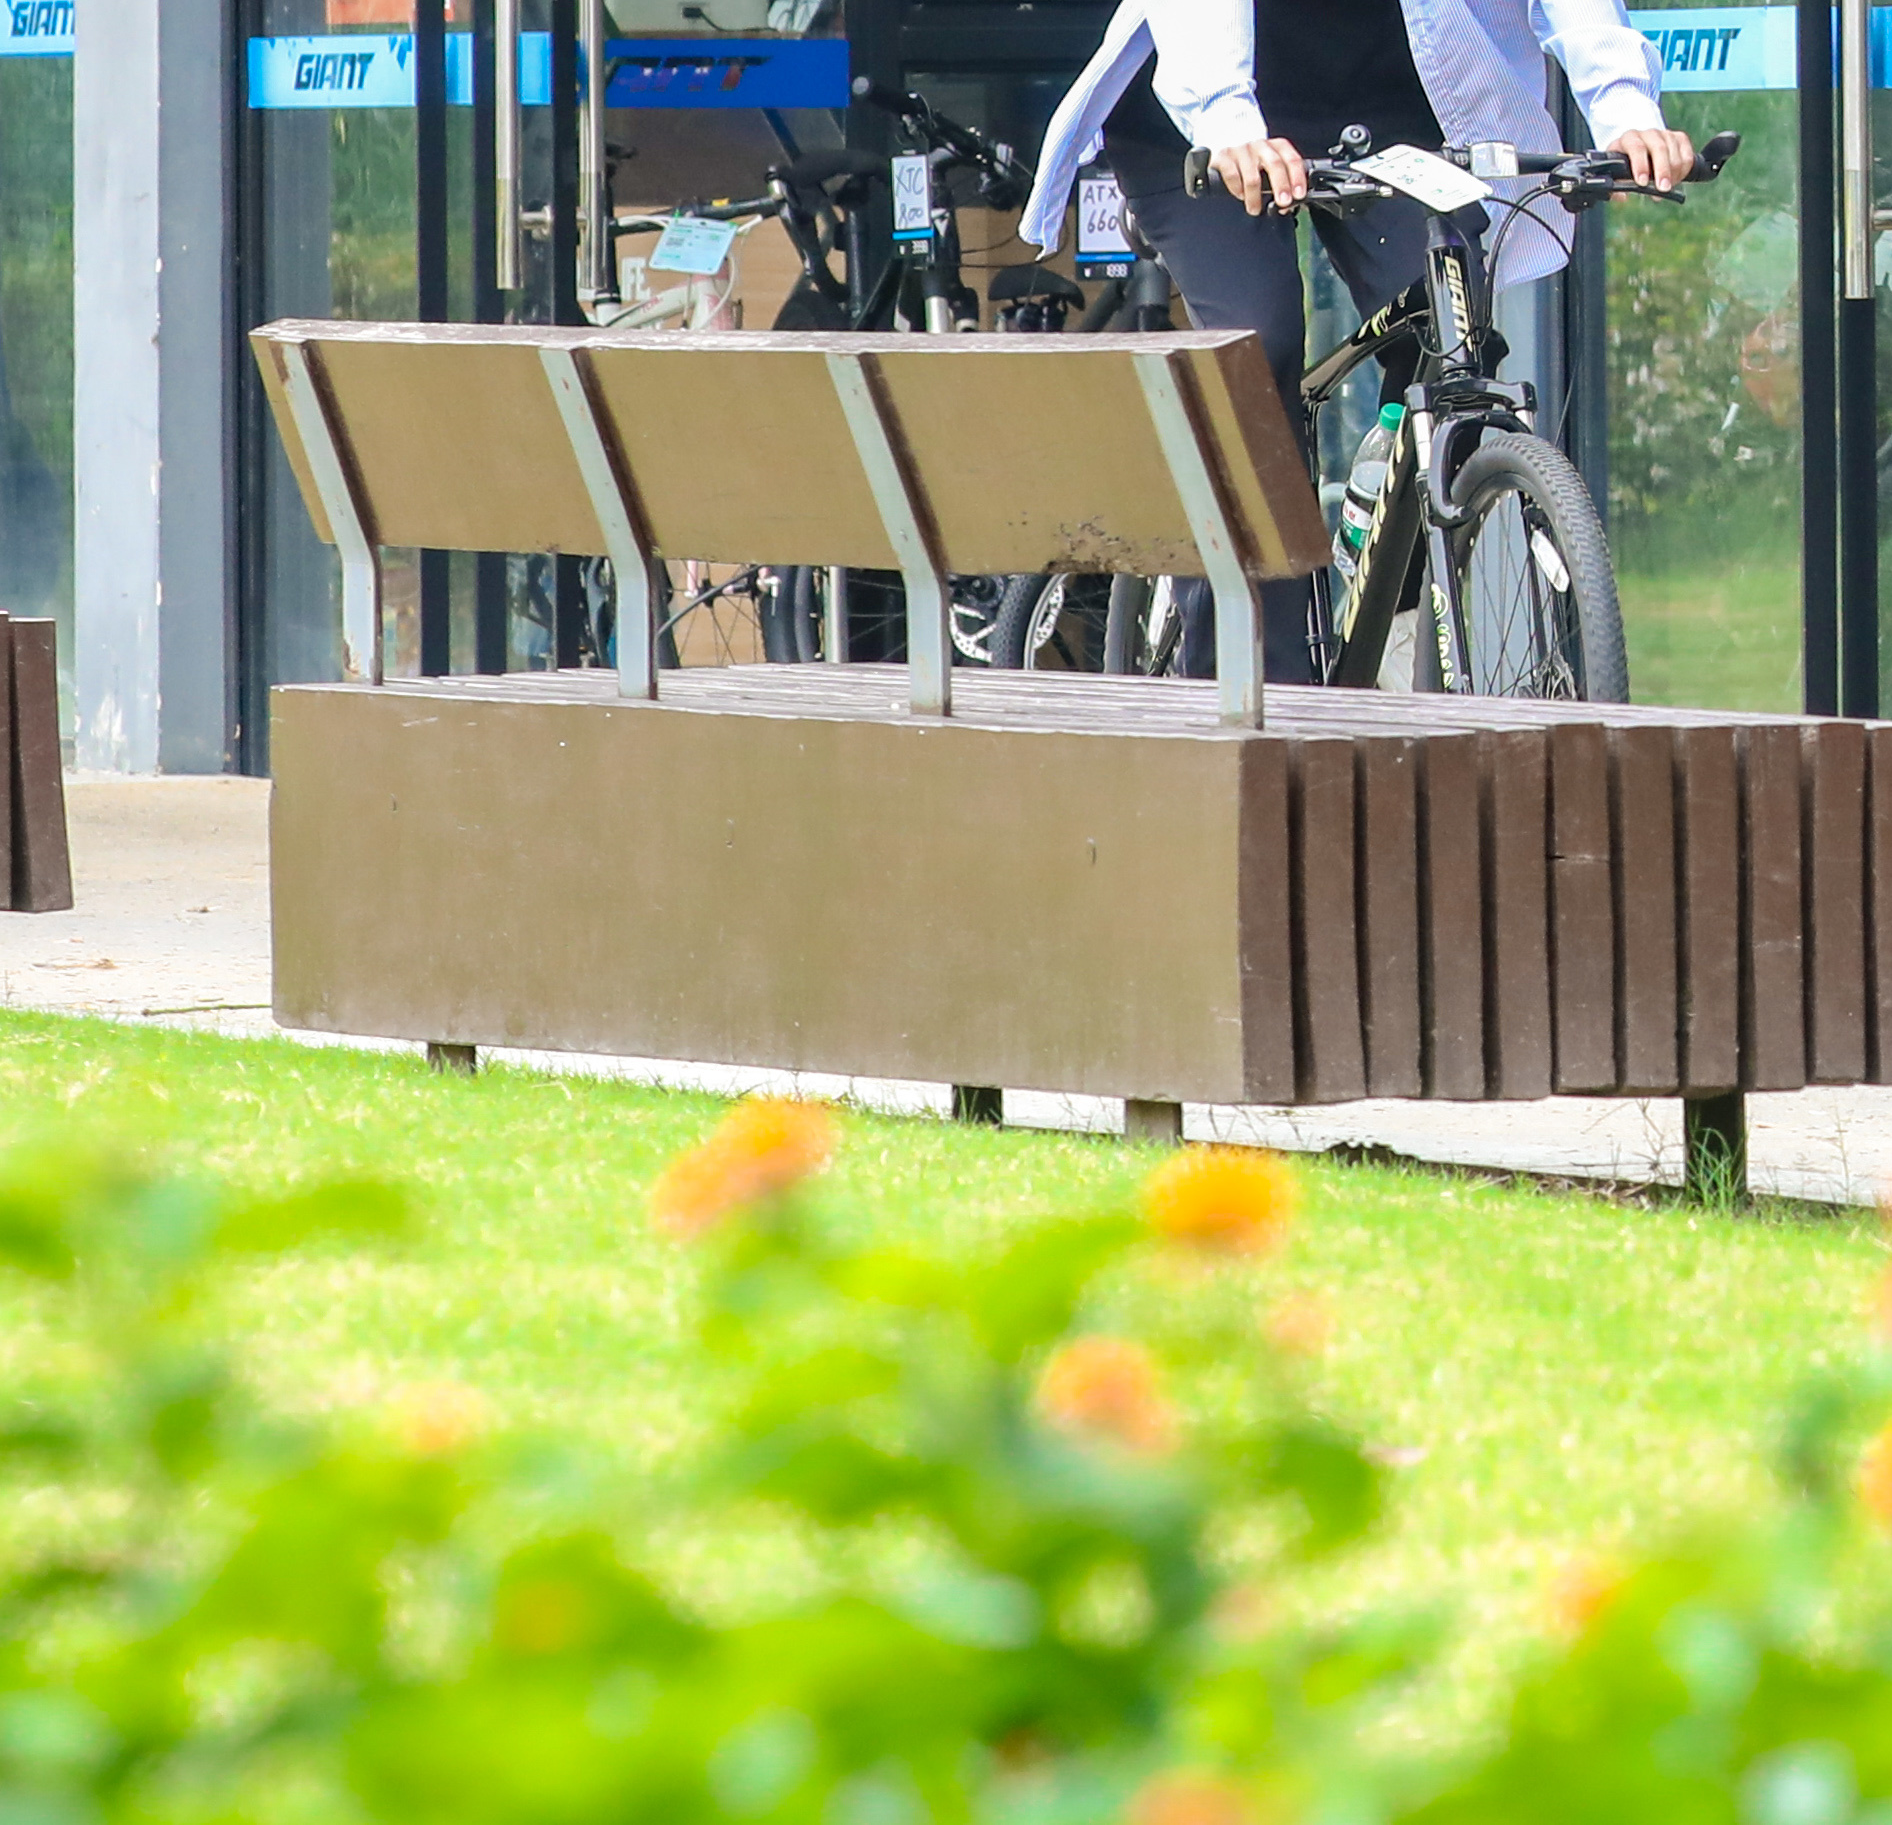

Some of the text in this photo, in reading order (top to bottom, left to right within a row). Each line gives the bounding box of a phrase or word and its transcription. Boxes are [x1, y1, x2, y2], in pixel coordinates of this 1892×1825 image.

[293, 52, 375, 91] GIANT
[1083, 184, 1119, 205] ATX
[1087, 207, 1120, 234] 660
